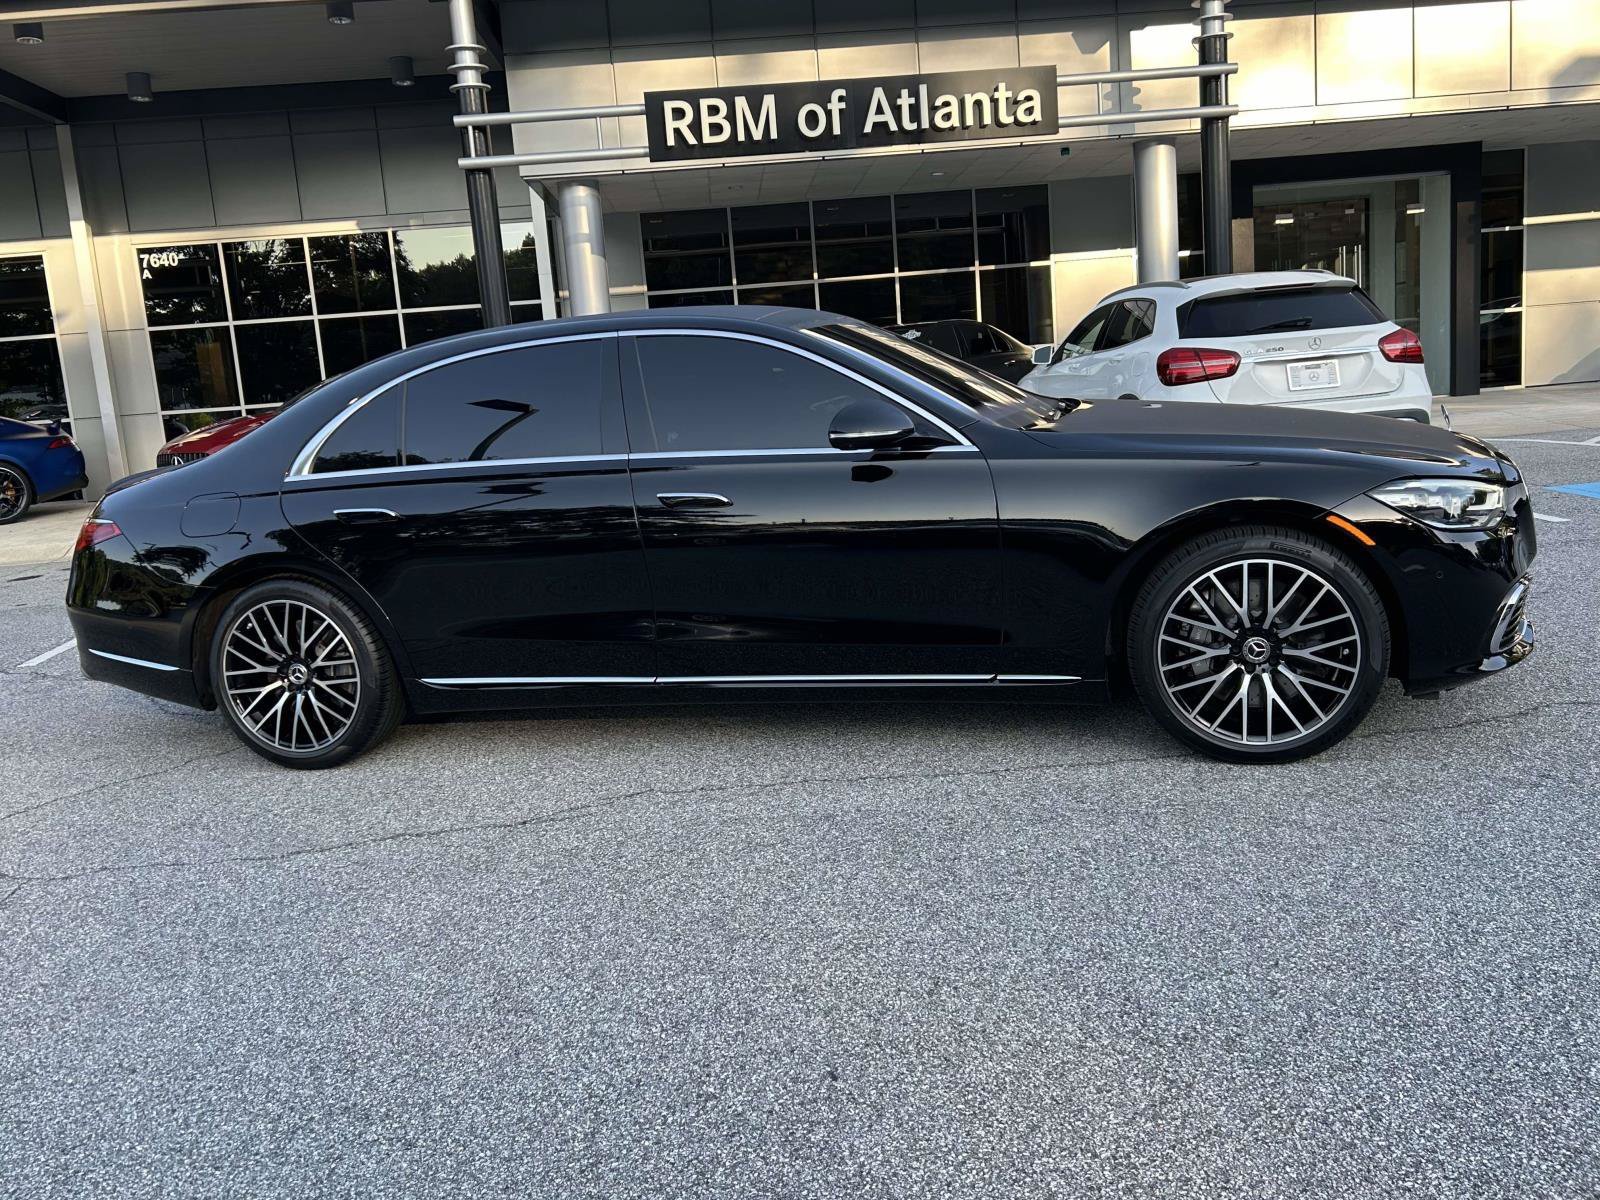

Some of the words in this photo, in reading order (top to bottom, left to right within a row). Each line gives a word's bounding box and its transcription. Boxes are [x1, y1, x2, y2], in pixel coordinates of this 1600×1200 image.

[663, 94, 778, 147] RBM
[797, 88, 846, 138] of
[863, 82, 1043, 133] Atlanta
[140, 252, 178, 268] 7640
[142, 269, 152, 279] A
